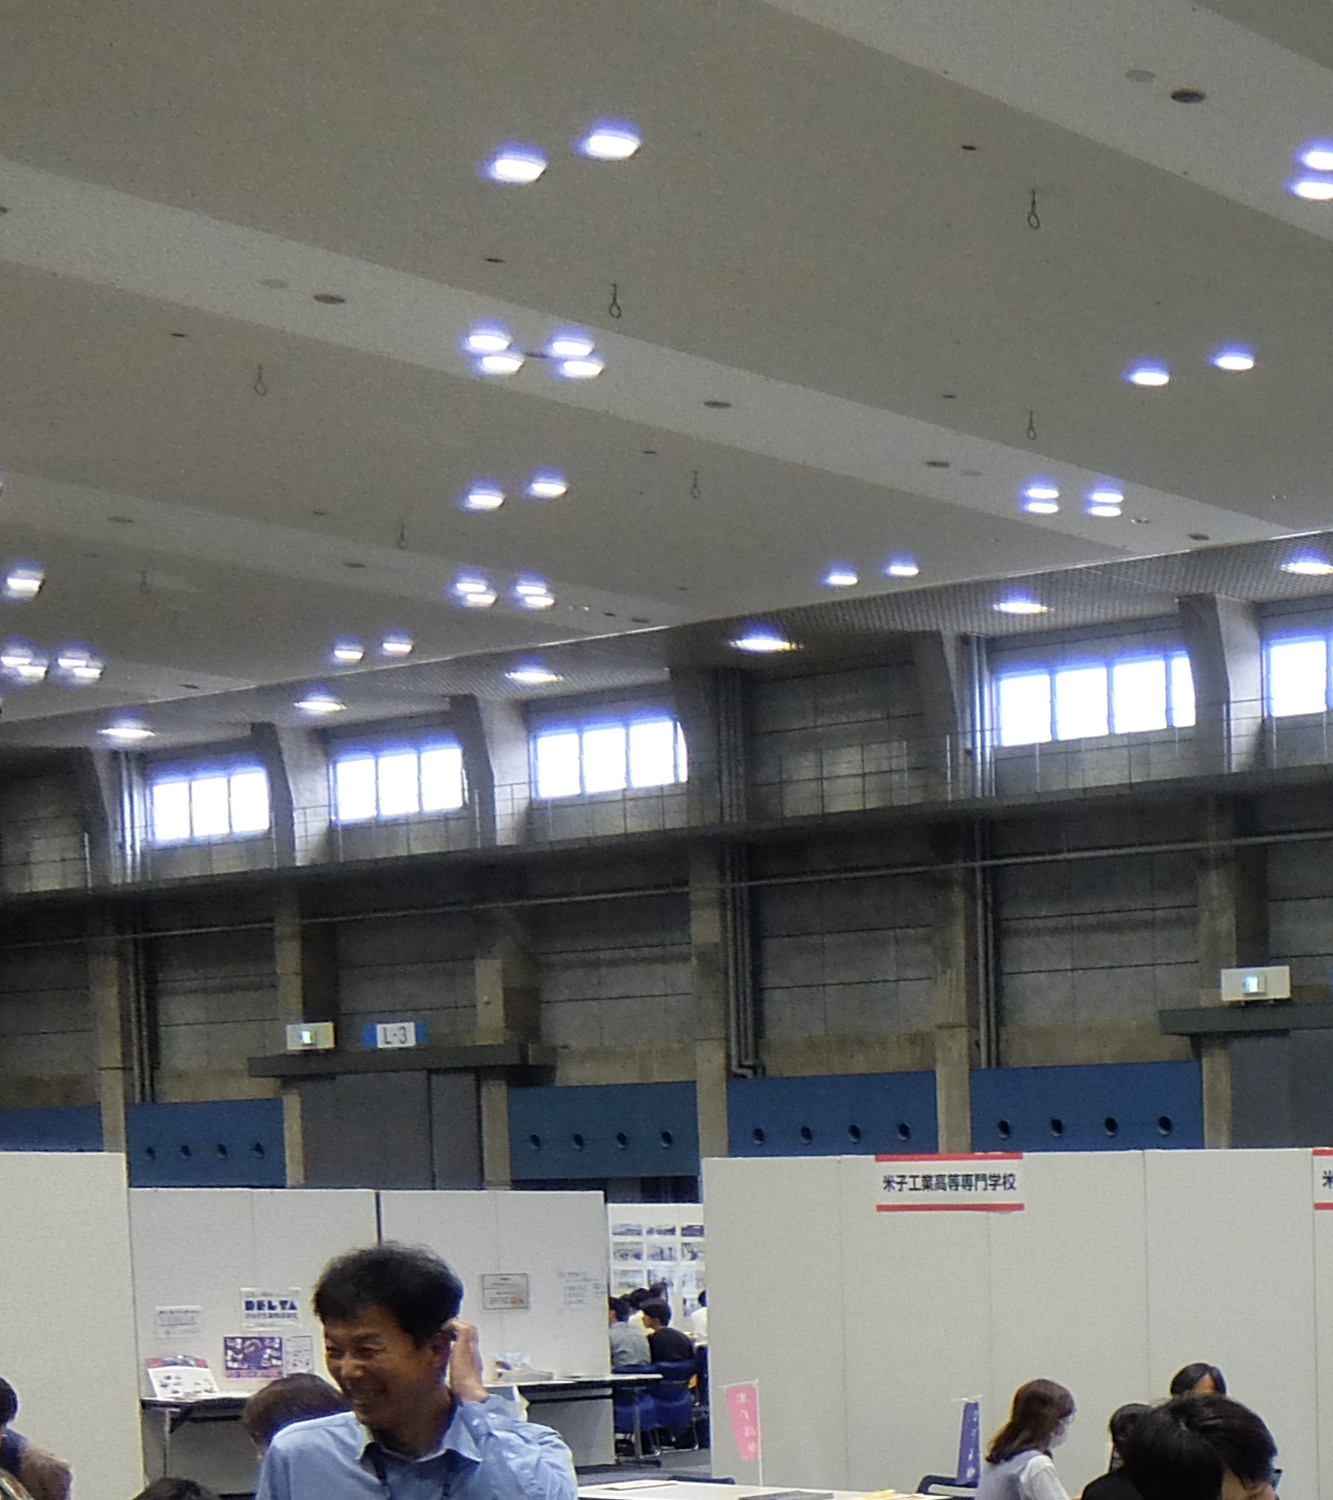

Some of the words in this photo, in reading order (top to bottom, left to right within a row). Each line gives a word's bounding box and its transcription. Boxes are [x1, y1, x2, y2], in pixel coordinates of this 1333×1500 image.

[383, 1025, 408, 1045] L-3
[882, 1173, 1017, 1192] 米子工業高等専門学校
